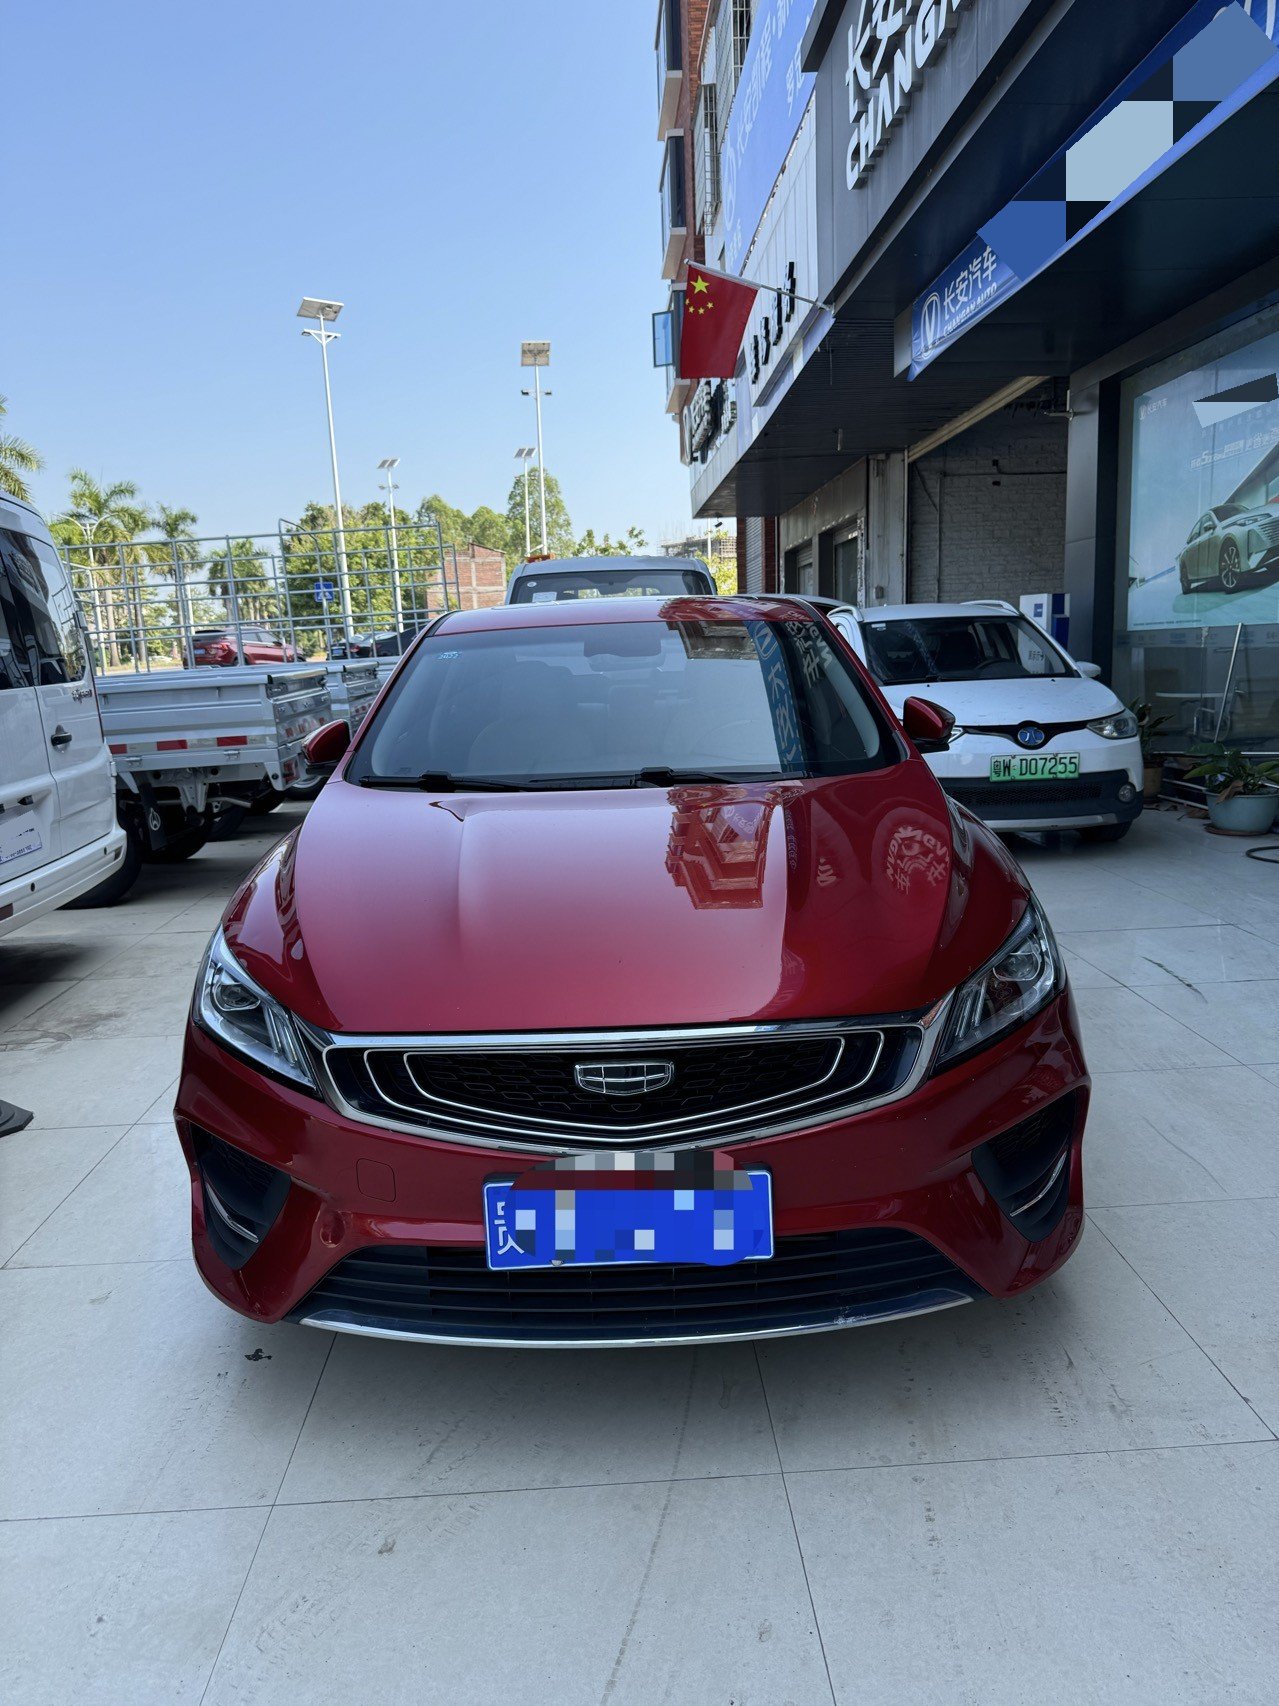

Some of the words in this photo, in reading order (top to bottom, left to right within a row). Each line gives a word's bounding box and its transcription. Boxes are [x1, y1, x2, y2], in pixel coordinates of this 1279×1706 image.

[845, 0, 912, 124] 长安
[943, 245, 997, 320] 长安汽车
[977, 281, 997, 307] AUTO
